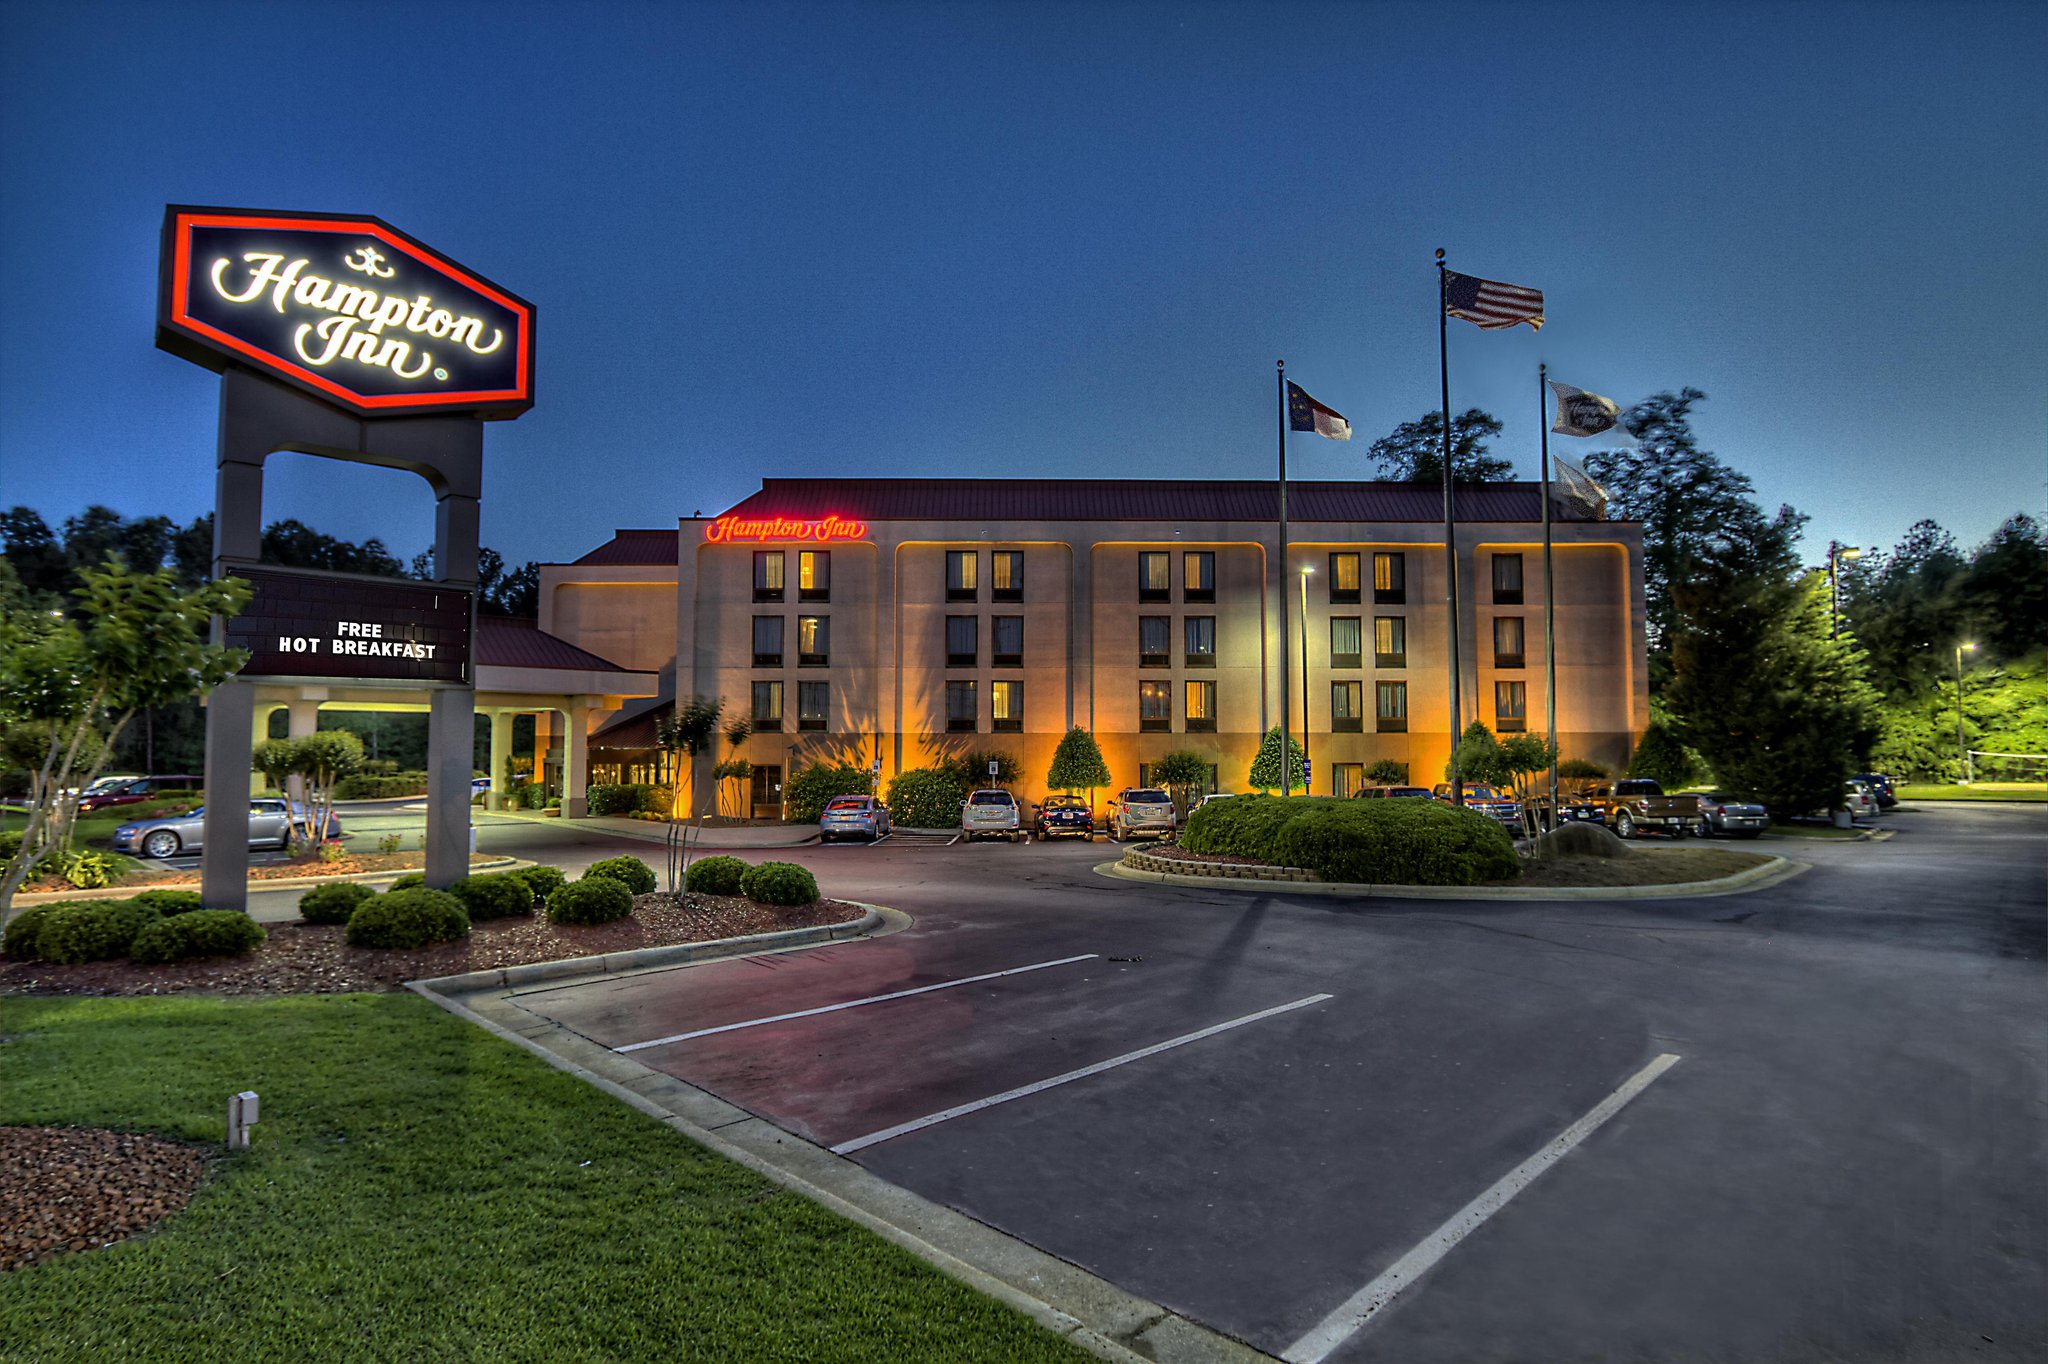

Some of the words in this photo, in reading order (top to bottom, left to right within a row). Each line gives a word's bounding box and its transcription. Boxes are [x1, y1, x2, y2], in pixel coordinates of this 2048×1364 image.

[211, 252, 503, 354] Hampton
[295, 316, 431, 378] Inn
[707, 516, 811, 541] Hampton
[816, 515, 865, 540] Inn
[338, 621, 382, 638] FREE
[279, 637, 320, 653] HOT
[332, 639, 435, 658] BREAKFAST
